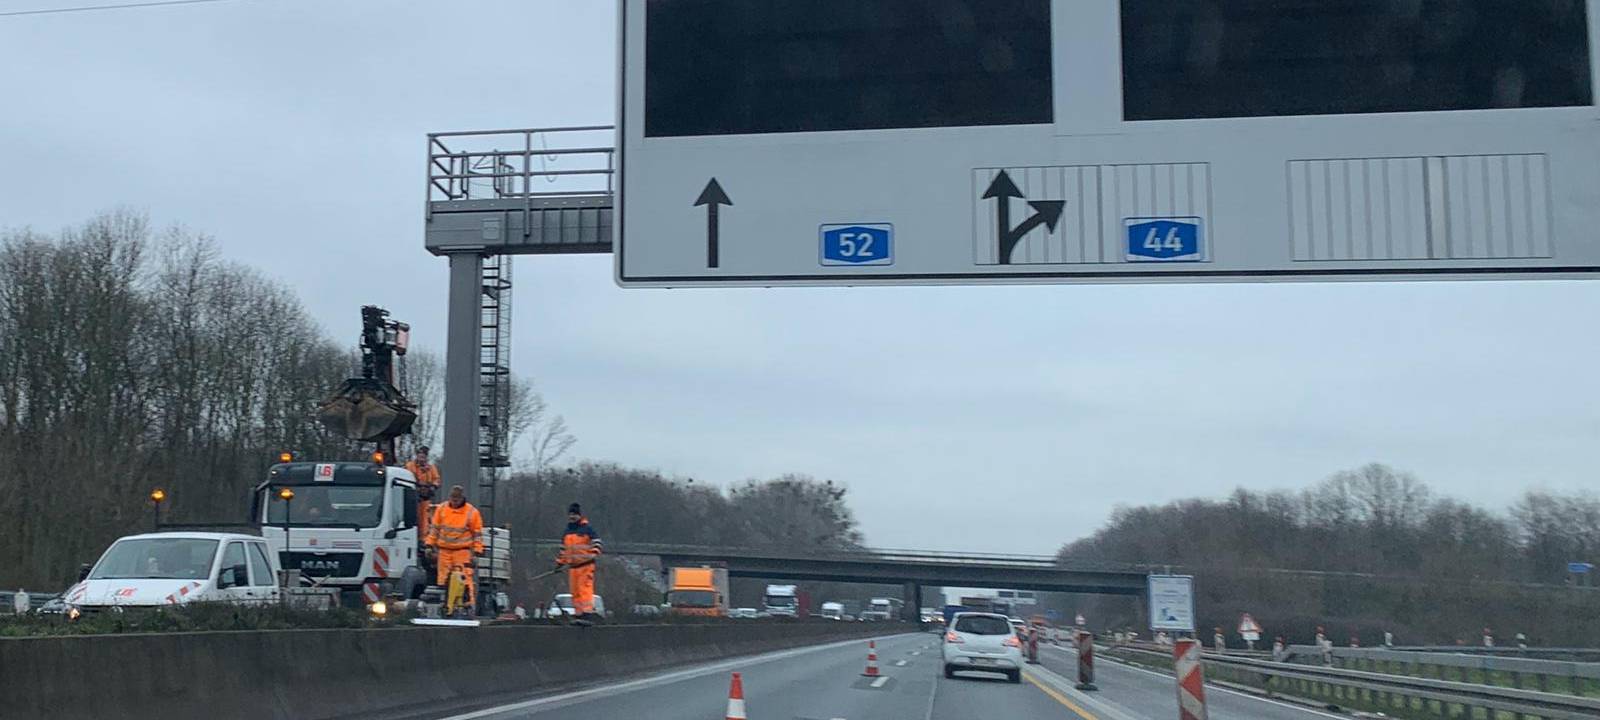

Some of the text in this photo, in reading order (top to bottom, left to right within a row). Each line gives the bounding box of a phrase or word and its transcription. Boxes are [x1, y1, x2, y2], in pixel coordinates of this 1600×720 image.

[839, 233, 874, 257] 52
[1143, 227, 1184, 252] 44
[301, 560, 340, 569] MAN
